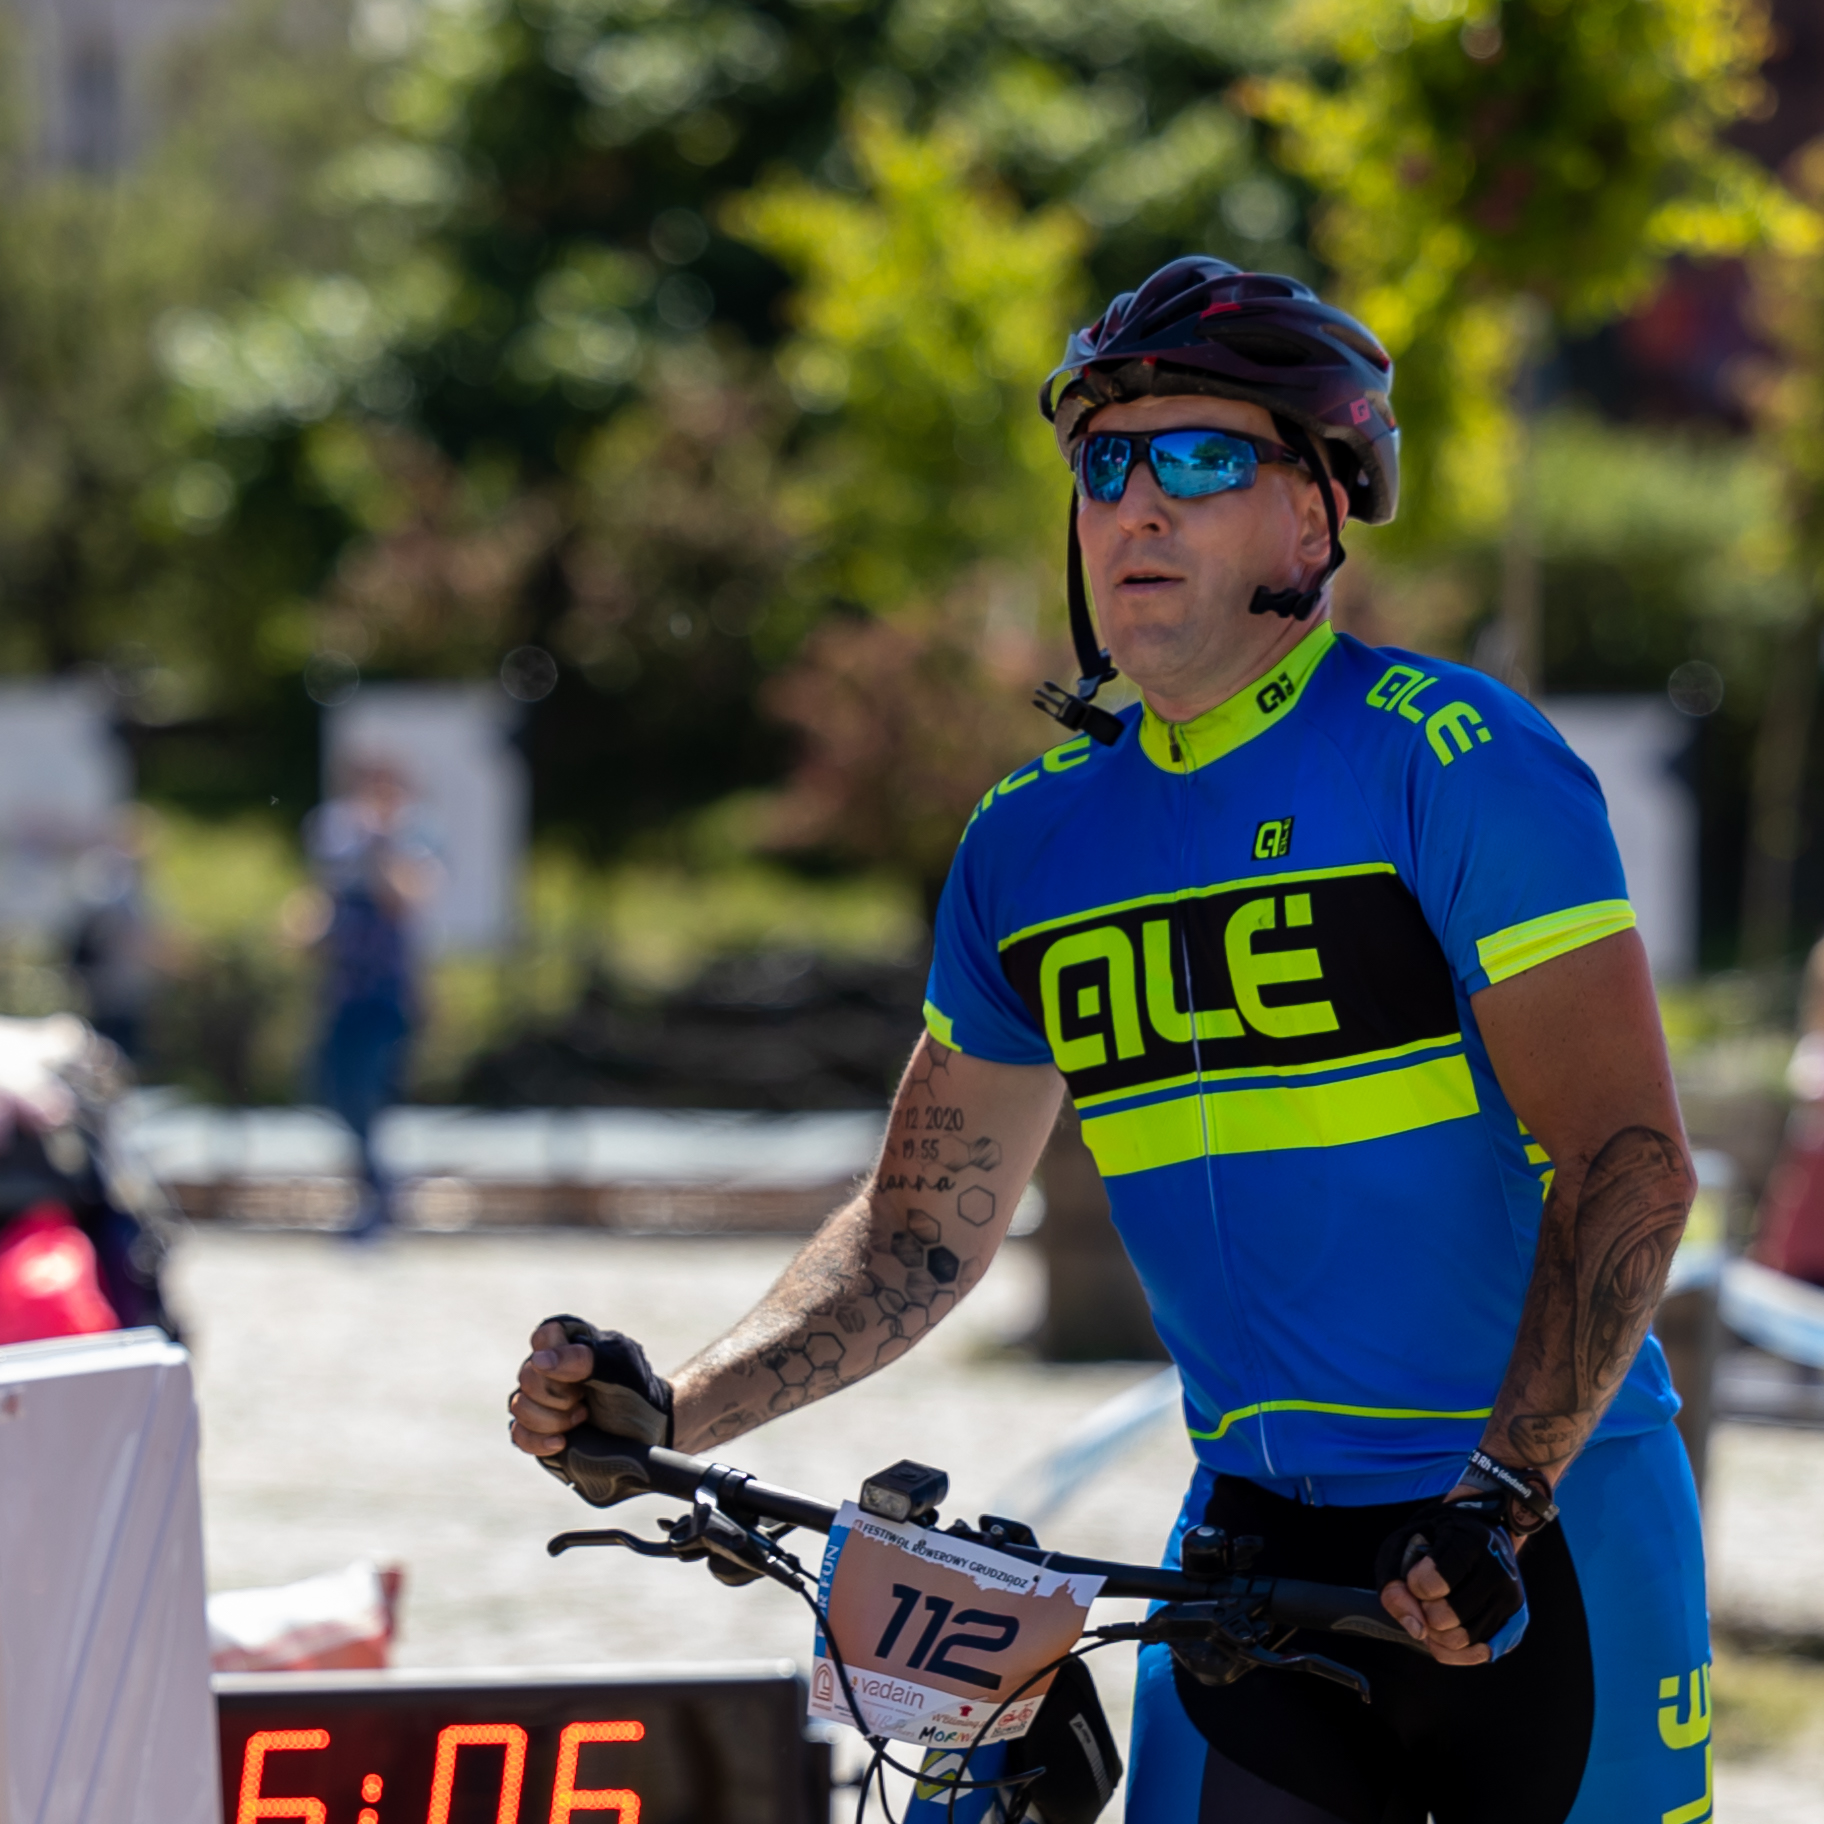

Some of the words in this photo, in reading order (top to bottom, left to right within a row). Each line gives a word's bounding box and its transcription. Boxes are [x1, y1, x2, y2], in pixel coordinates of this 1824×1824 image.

[863, 1523, 910, 1550] FESTIWAL
[819, 1545, 840, 1588] FUN
[875, 1583, 1020, 1691] 112
[862, 1678, 925, 1709] vadain
